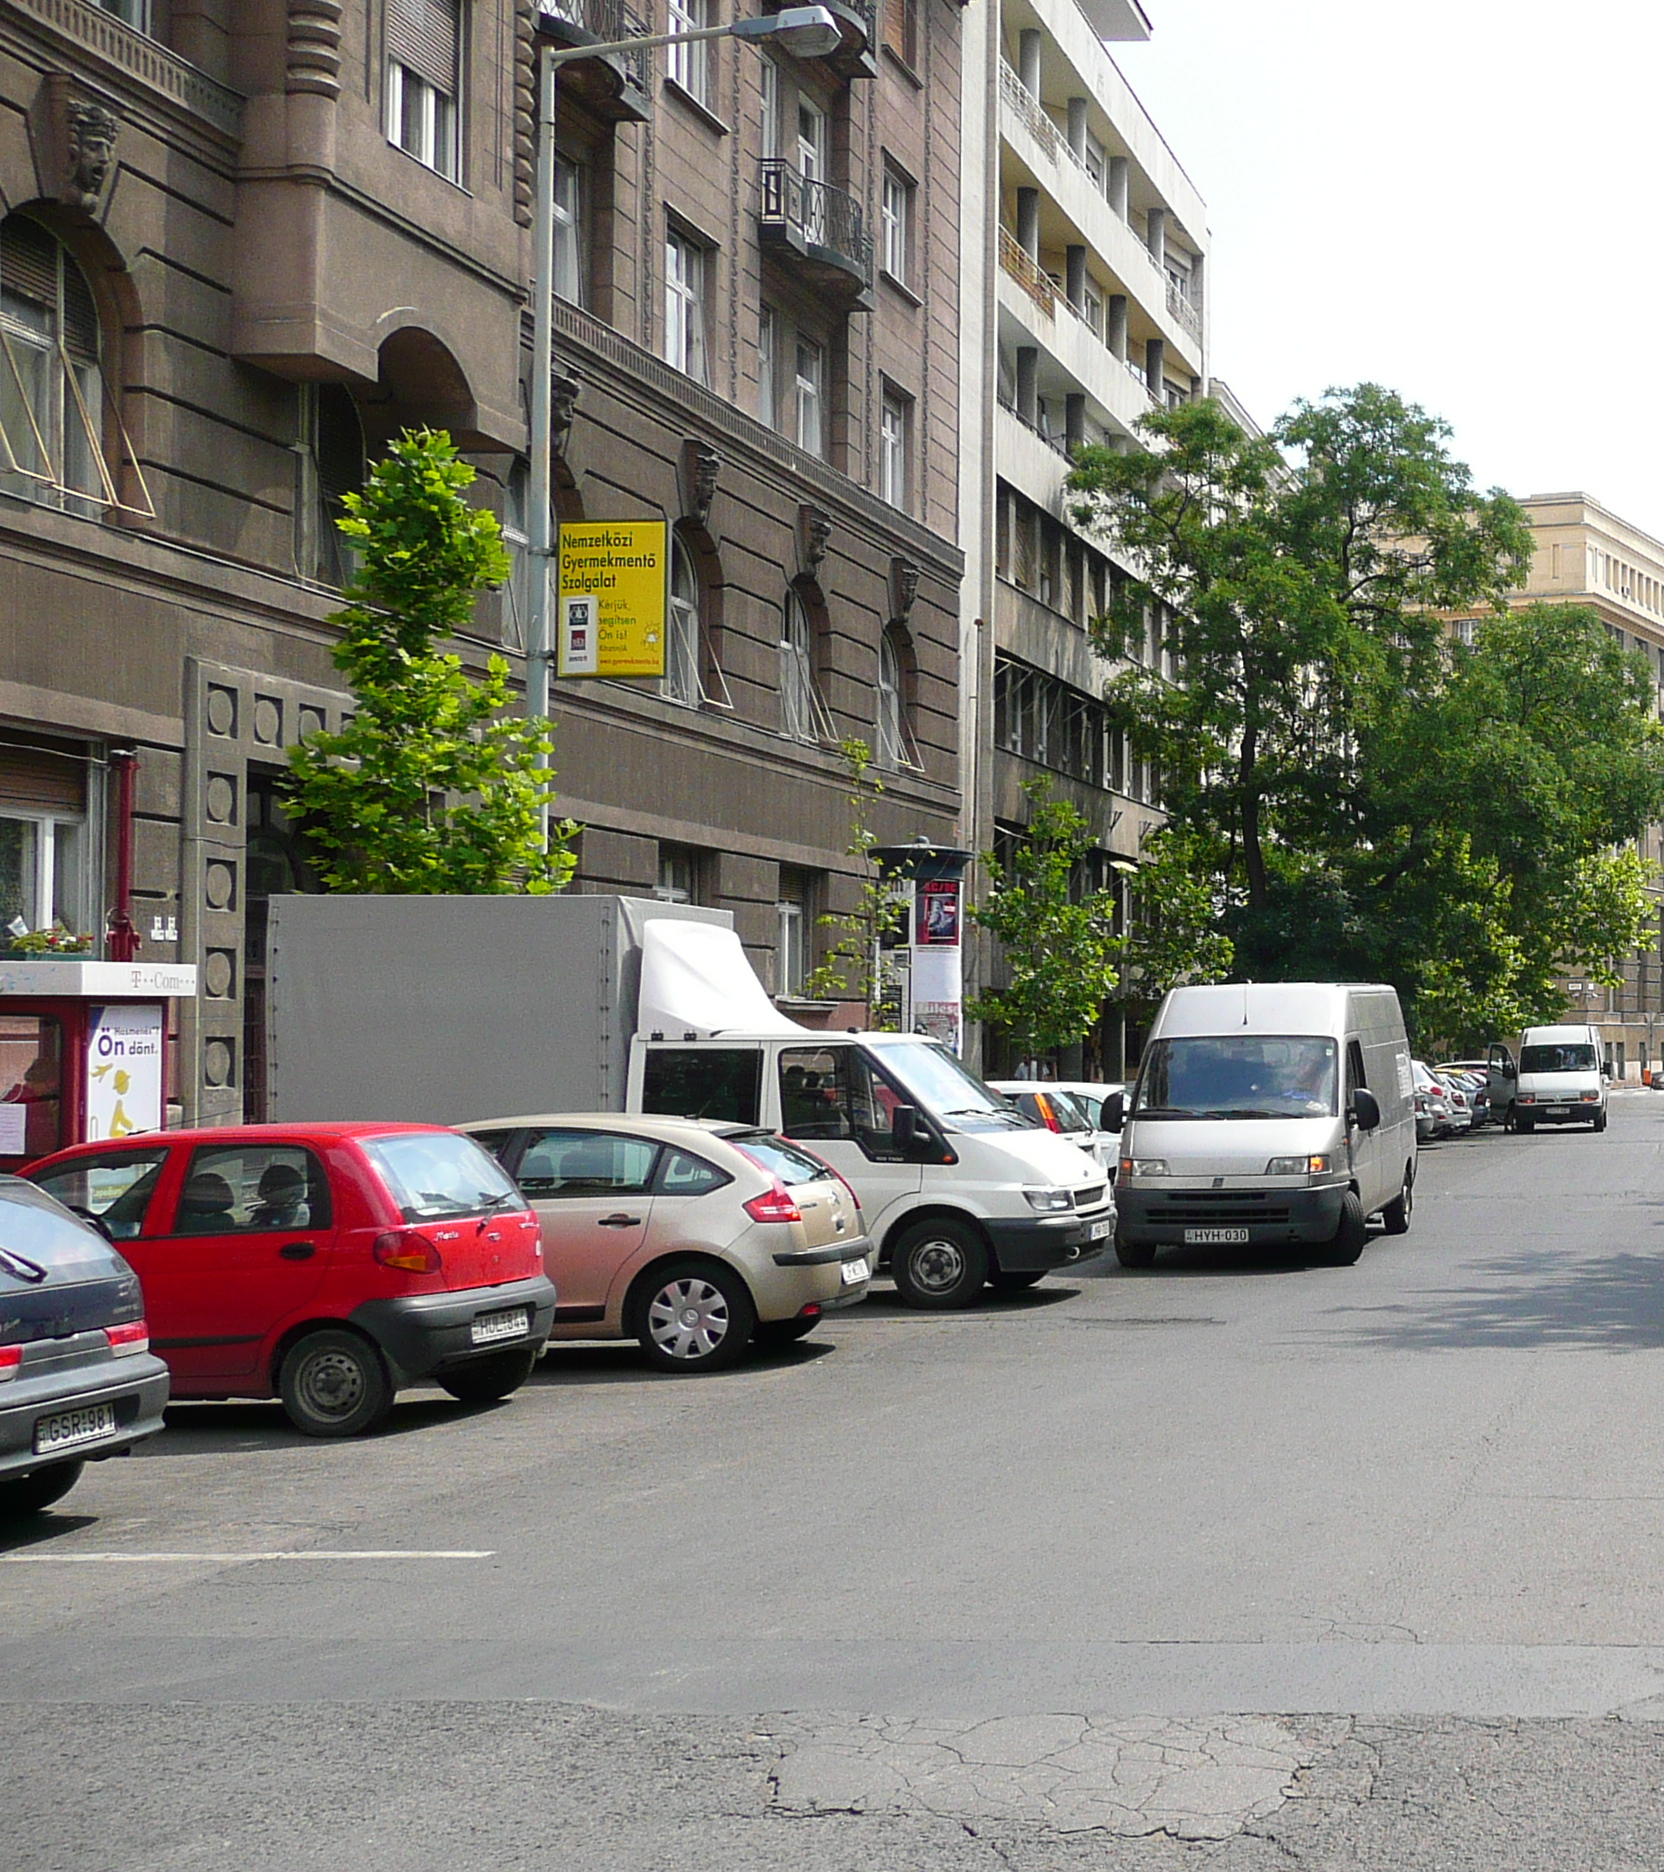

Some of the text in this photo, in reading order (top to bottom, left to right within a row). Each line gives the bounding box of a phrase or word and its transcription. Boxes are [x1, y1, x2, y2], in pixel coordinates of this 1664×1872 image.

[562, 530, 633, 549] Nemzetközi
[562, 572, 617, 593] Szolgálat
[98, 1026, 125, 1057] Ön
